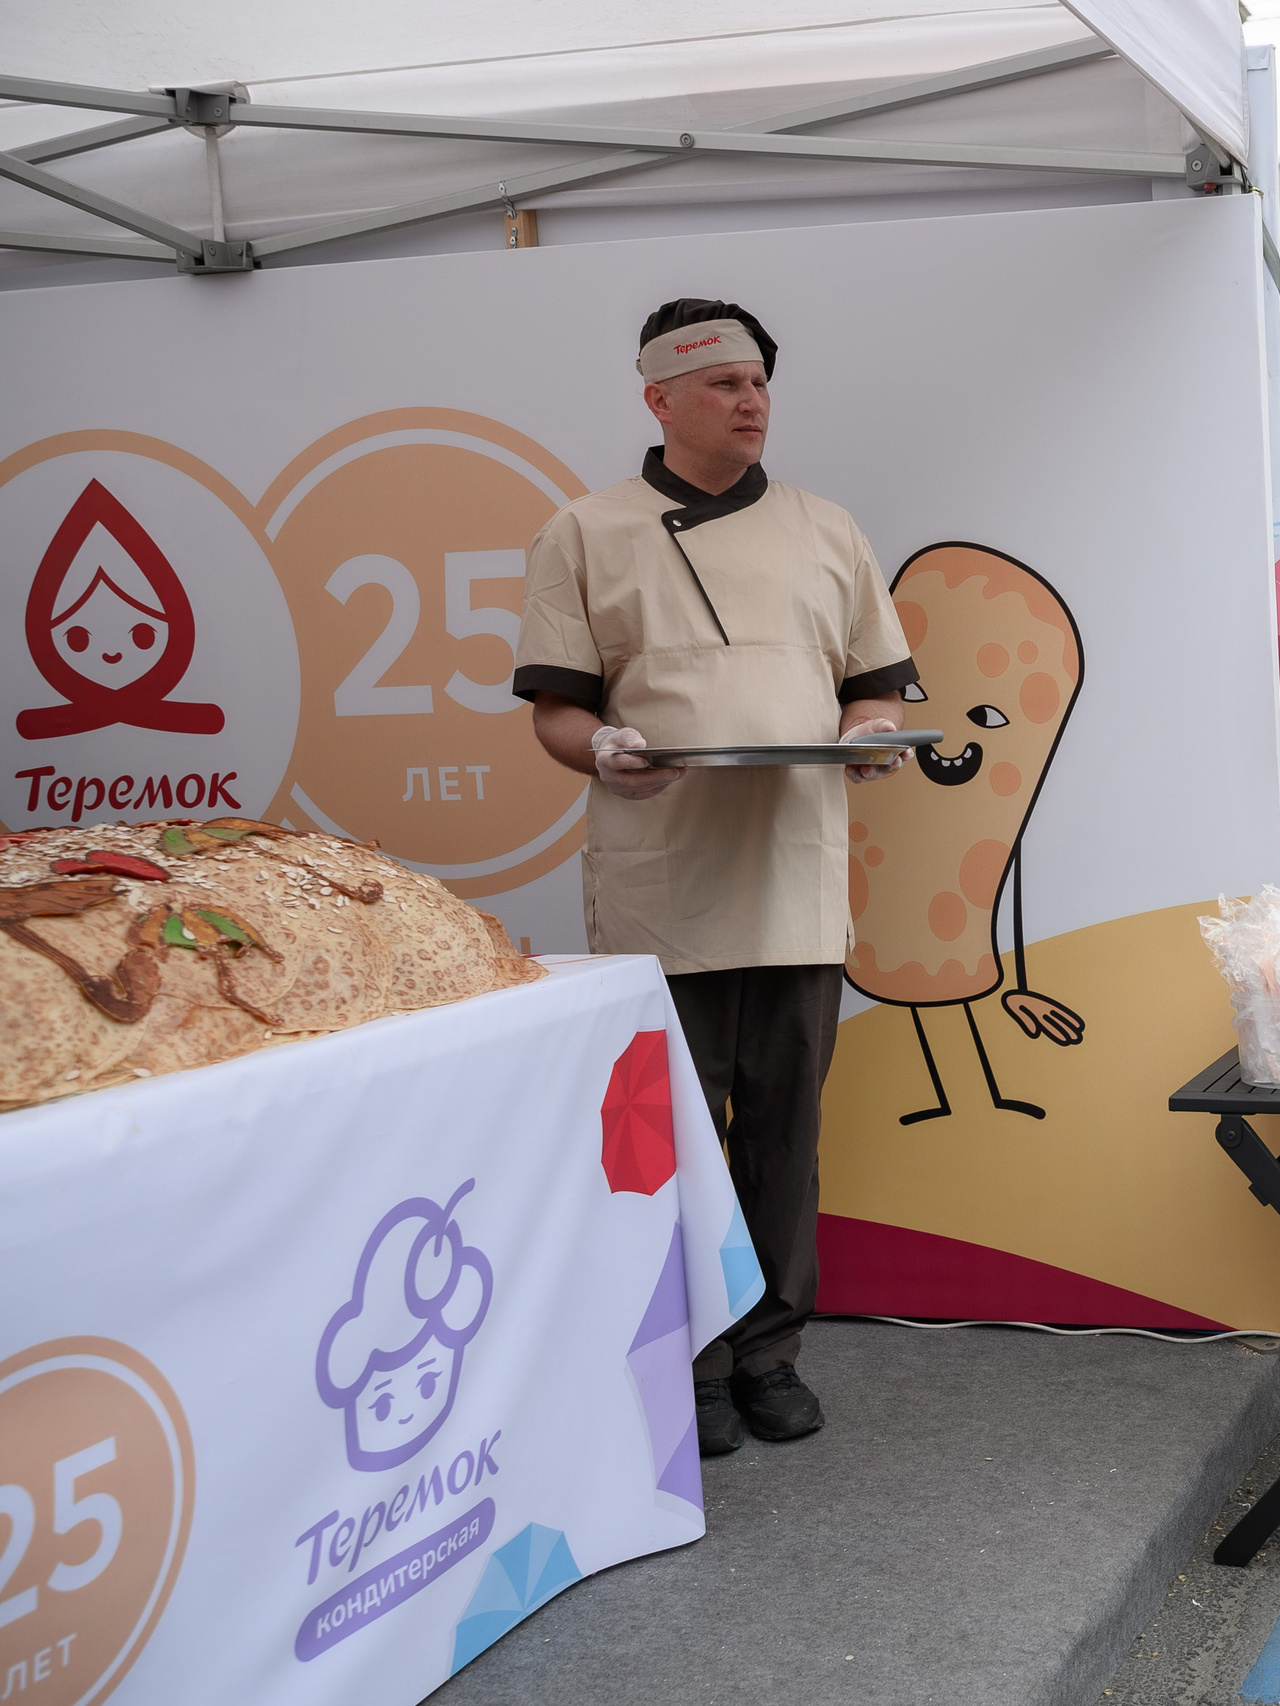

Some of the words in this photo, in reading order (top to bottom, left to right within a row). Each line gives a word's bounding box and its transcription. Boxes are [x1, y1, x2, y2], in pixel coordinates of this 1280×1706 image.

[673, 335, 722, 355] Теремок
[324, 548, 532, 717] 25
[15, 765, 242, 823] Теремок
[402, 765, 491, 802] ЛЕТ
[295, 1429, 502, 1586] Теремок
[316, 1516, 480, 1640] кондитерская
[1, 1632, 78, 1700] ЛЕТ
